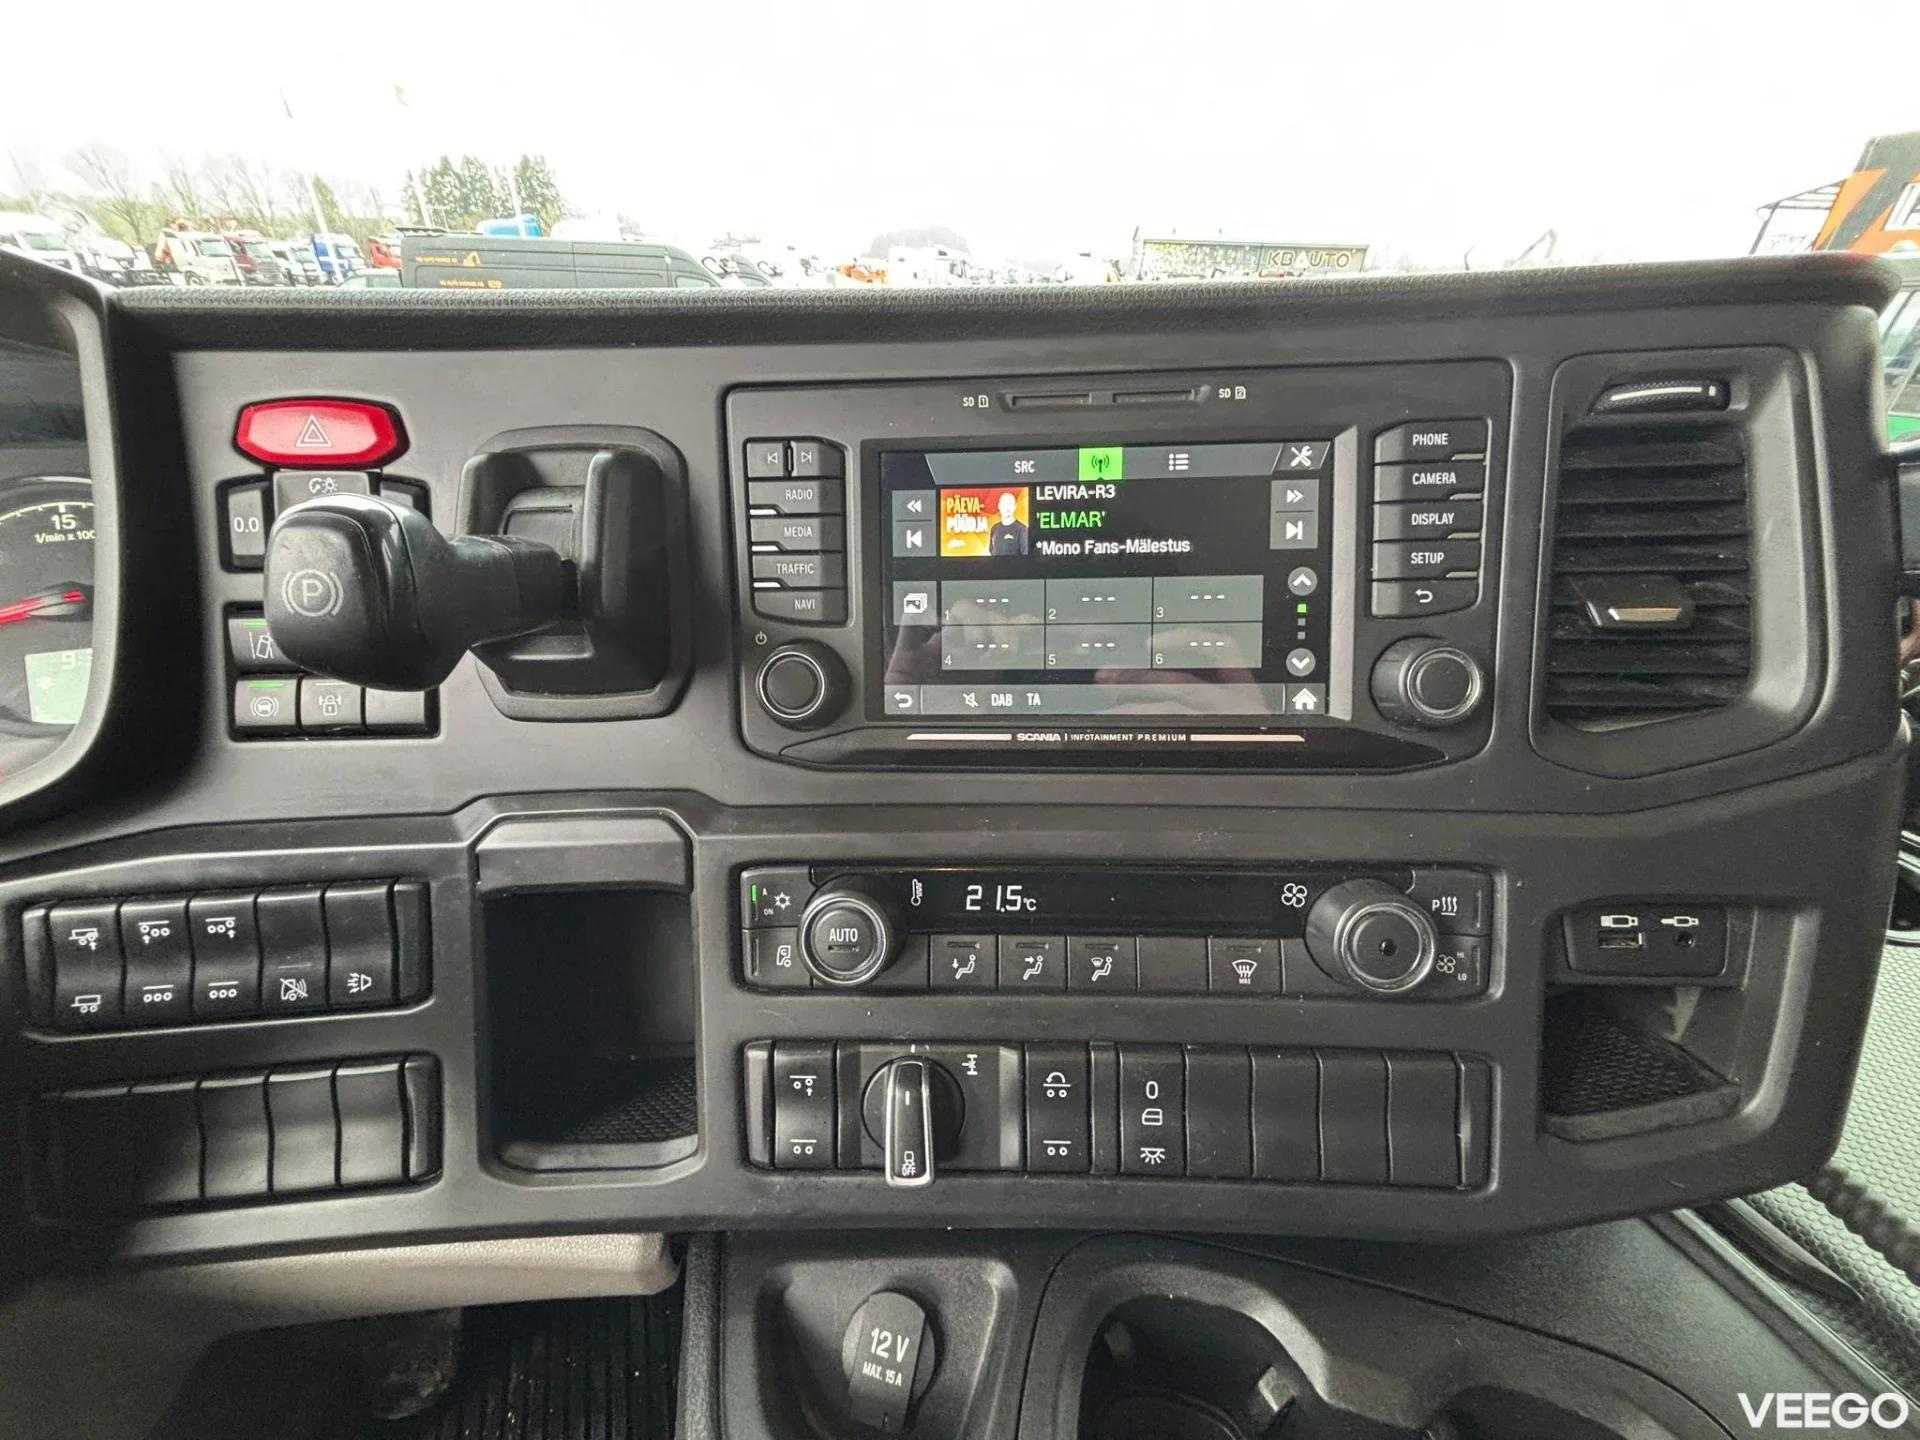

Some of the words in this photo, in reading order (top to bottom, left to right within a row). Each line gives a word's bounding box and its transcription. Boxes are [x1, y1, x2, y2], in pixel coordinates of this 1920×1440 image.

[1218, 387, 1231, 399] SD
[962, 396, 975, 407] SD
[1412, 433, 1449, 446] PHONE
[1013, 459, 1035, 474] SRC
[1412, 472, 1457, 485] CAMERA
[785, 488, 813, 500] RADIO
[1035, 484, 1116, 501] LEVIRA-R3
[51, 513, 77, 530] 15
[233, 516, 260, 533] 0.0
[1036, 511, 1106, 530] 'ELMAR'
[1411, 513, 1455, 526] DISPLAY
[783, 526, 813, 538] MEDIA
[1084, 538, 1191, 555] Fans-Mälestus
[1410, 552, 1445, 565] SETUP
[776, 563, 815, 575] TRAFFIC
[794, 599, 816, 610] NAVI
[1048, 608, 1057, 620] 2
[1155, 606, 1164, 618] 3
[944, 655, 953, 667] 4
[1048, 654, 1056, 666] 5
[1155, 653, 1164, 665] 6
[990, 693, 1013, 707] DAB
[1026, 692, 1041, 706] TA
[1016, 732, 1061, 742] SCANIA
[1070, 733, 1134, 742] INFOTAINMENT
[1137, 733, 1187, 742] PREMIUM
[828, 927, 859, 943] AUTO
[901, 1166, 917, 1177] OFF
[871, 1328, 892, 1359] 12
[896, 1335, 910, 1361] V
[862, 1361, 883, 1381] MAX.
